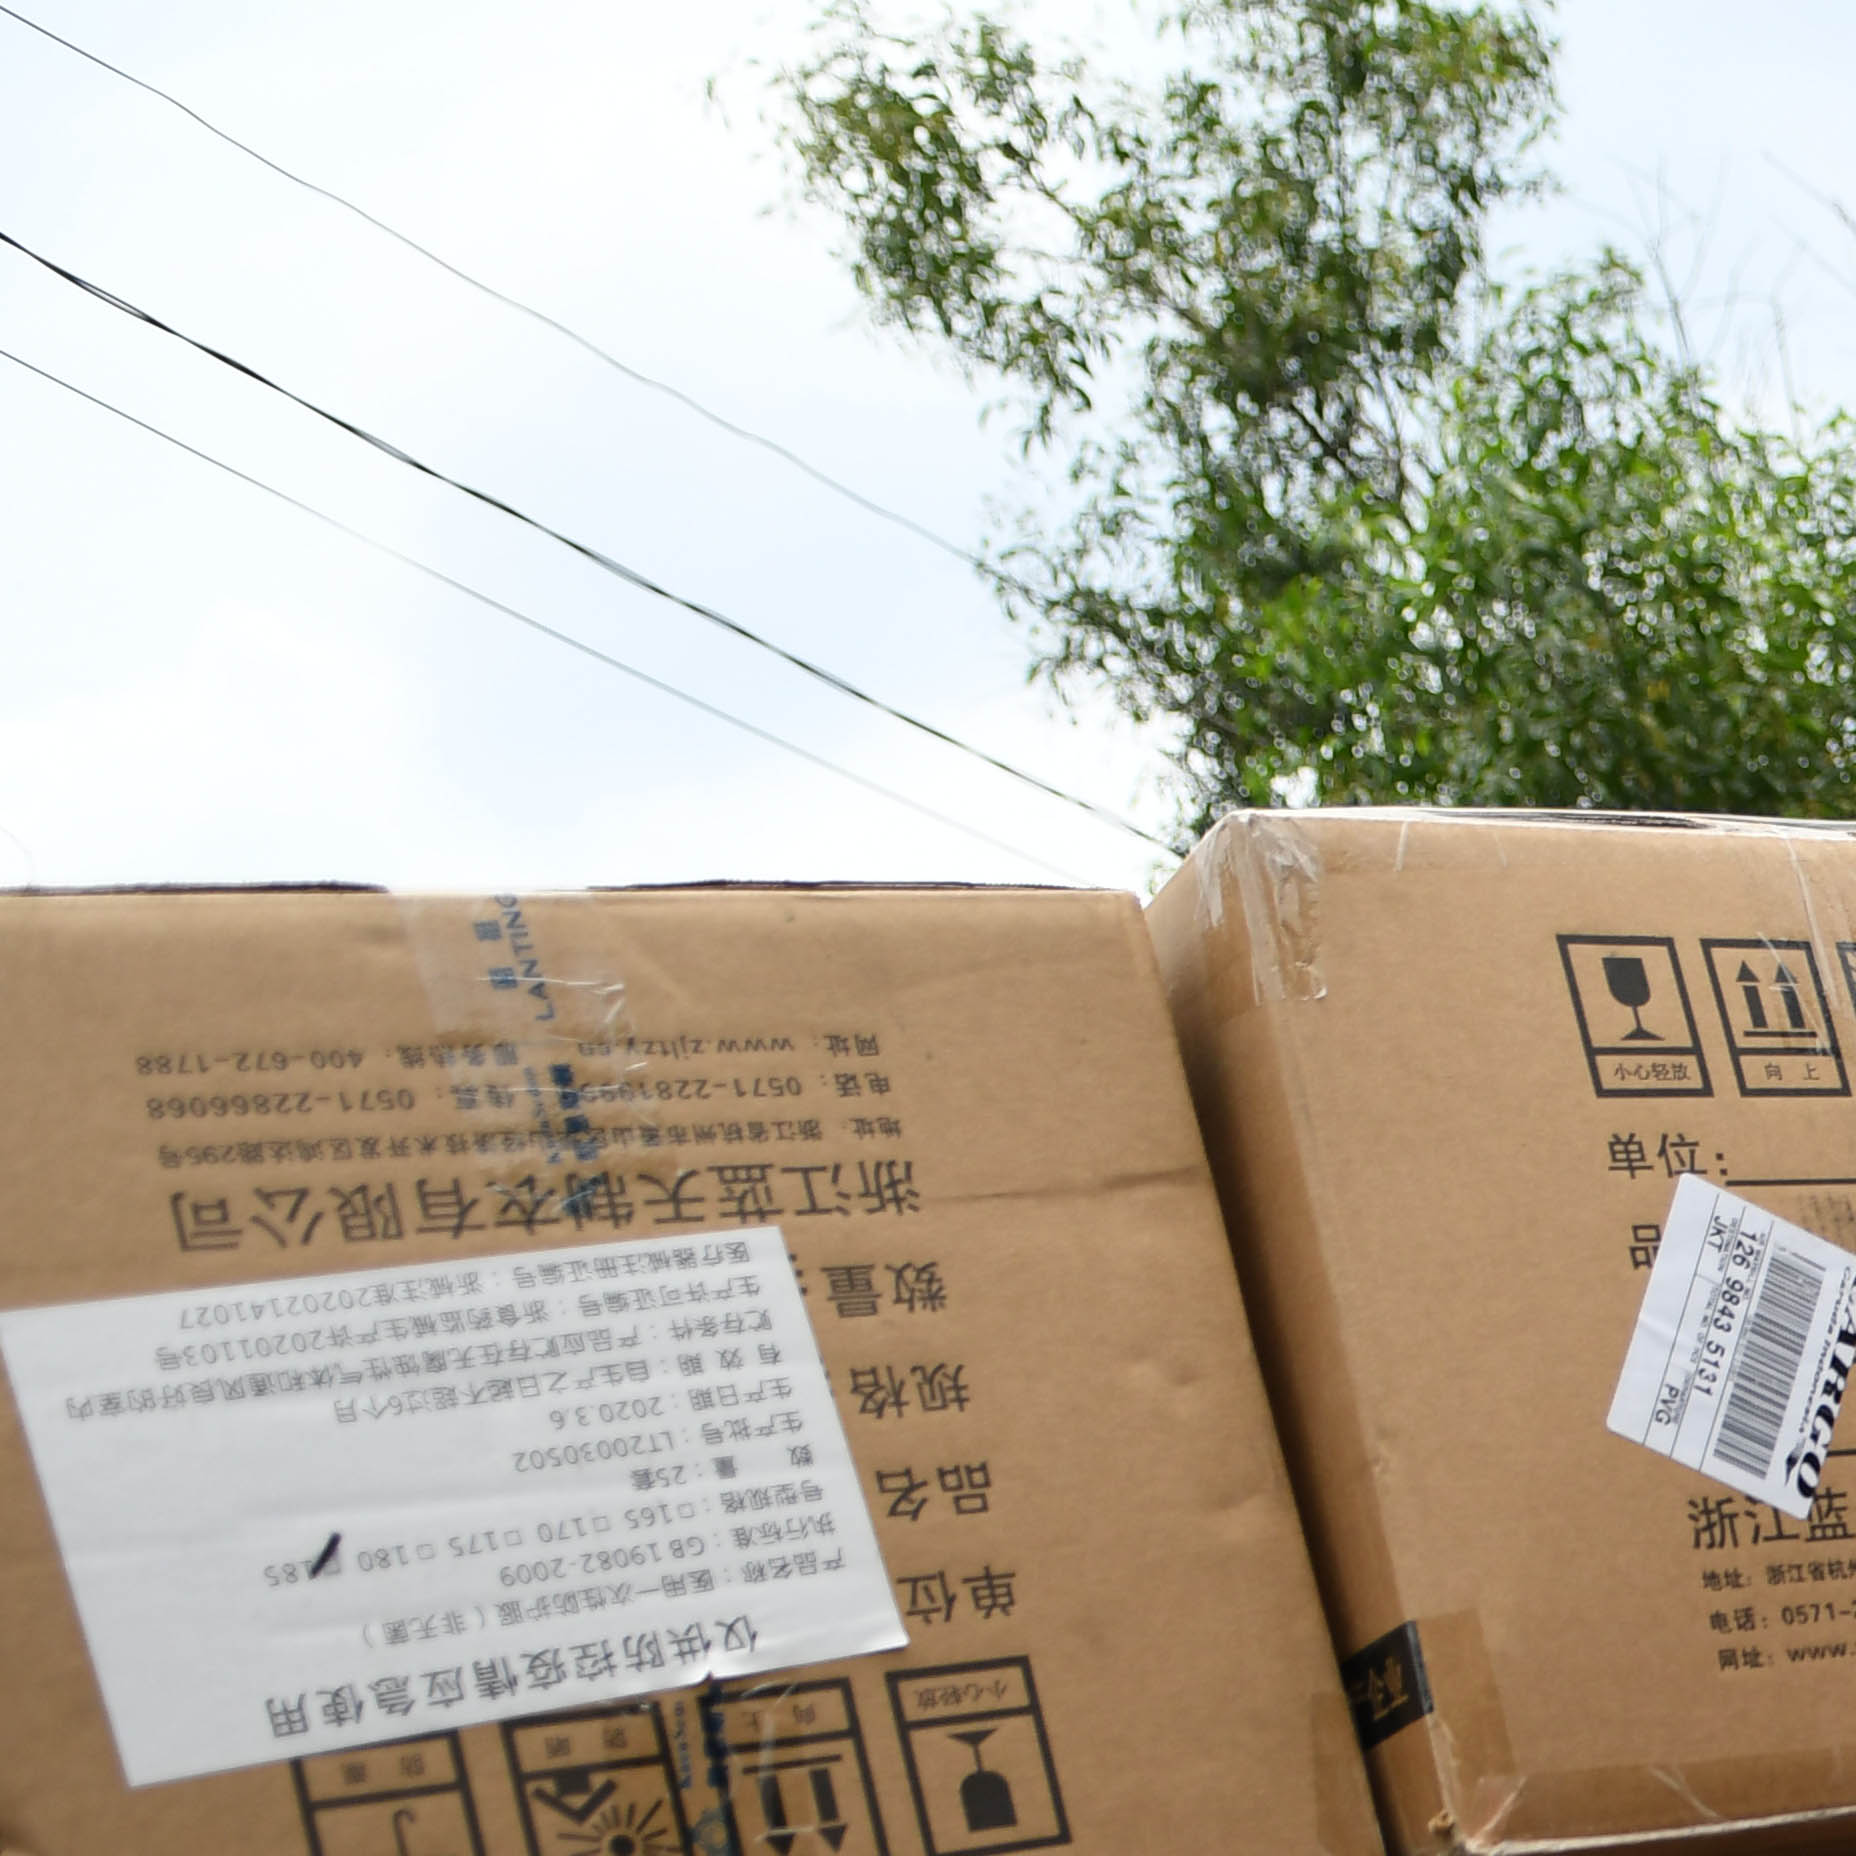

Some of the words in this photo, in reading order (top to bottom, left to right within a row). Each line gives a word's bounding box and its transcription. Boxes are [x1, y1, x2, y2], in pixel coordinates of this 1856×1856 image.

[1703, 1211, 1729, 1253] JKT
[1732, 1231, 1758, 1270] 126
[1712, 1277, 1745, 1333] 9843
[1693, 1340, 1726, 1396] 5131
[1651, 1383, 1680, 1426] PVG
[265, 1615, 758, 1739] 仅供防控疫情应急使用
